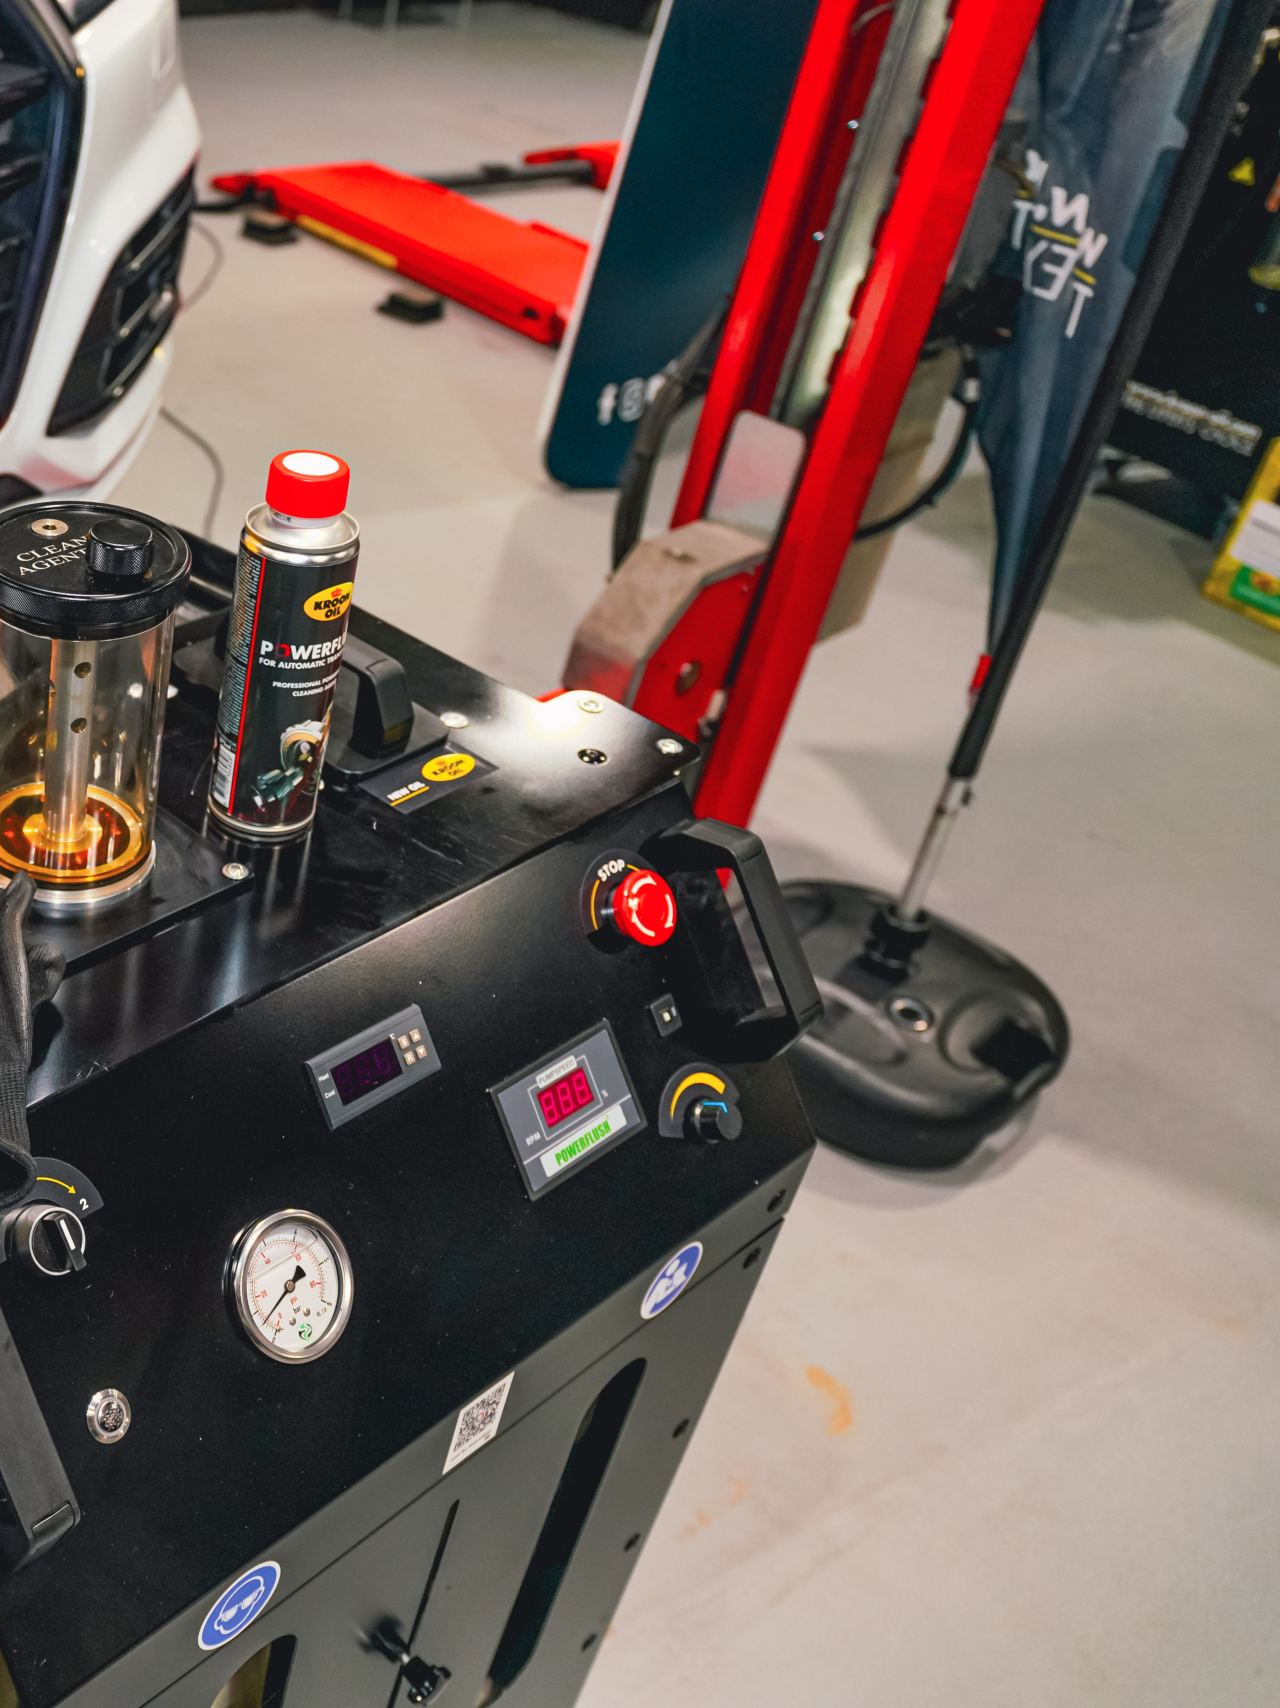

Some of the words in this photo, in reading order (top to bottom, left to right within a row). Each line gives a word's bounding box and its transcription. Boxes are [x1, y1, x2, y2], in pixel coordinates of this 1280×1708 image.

[313, 591, 351, 611] KROON
[324, 606, 341, 619] OIL
[258, 657, 276, 667] FOR
[277, 660, 326, 670] AUTOMATIC
[272, 679, 321, 689] PROFESSIONAL
[292, 687, 323, 697] CLEANING
[431, 759, 466, 776] KROON
[597, 858, 625, 882] STOP
[407, 1054, 414, 1063] R
[318, 1073, 329, 1082] Heat
[538, 1059, 575, 1085] PUMPSPEED
[325, 1089, 336, 1099] Cool
[525, 1131, 541, 1146] RPM
[554, 1120, 611, 1167] POWERFLUSH
[79, 1198, 89, 1211] 2
